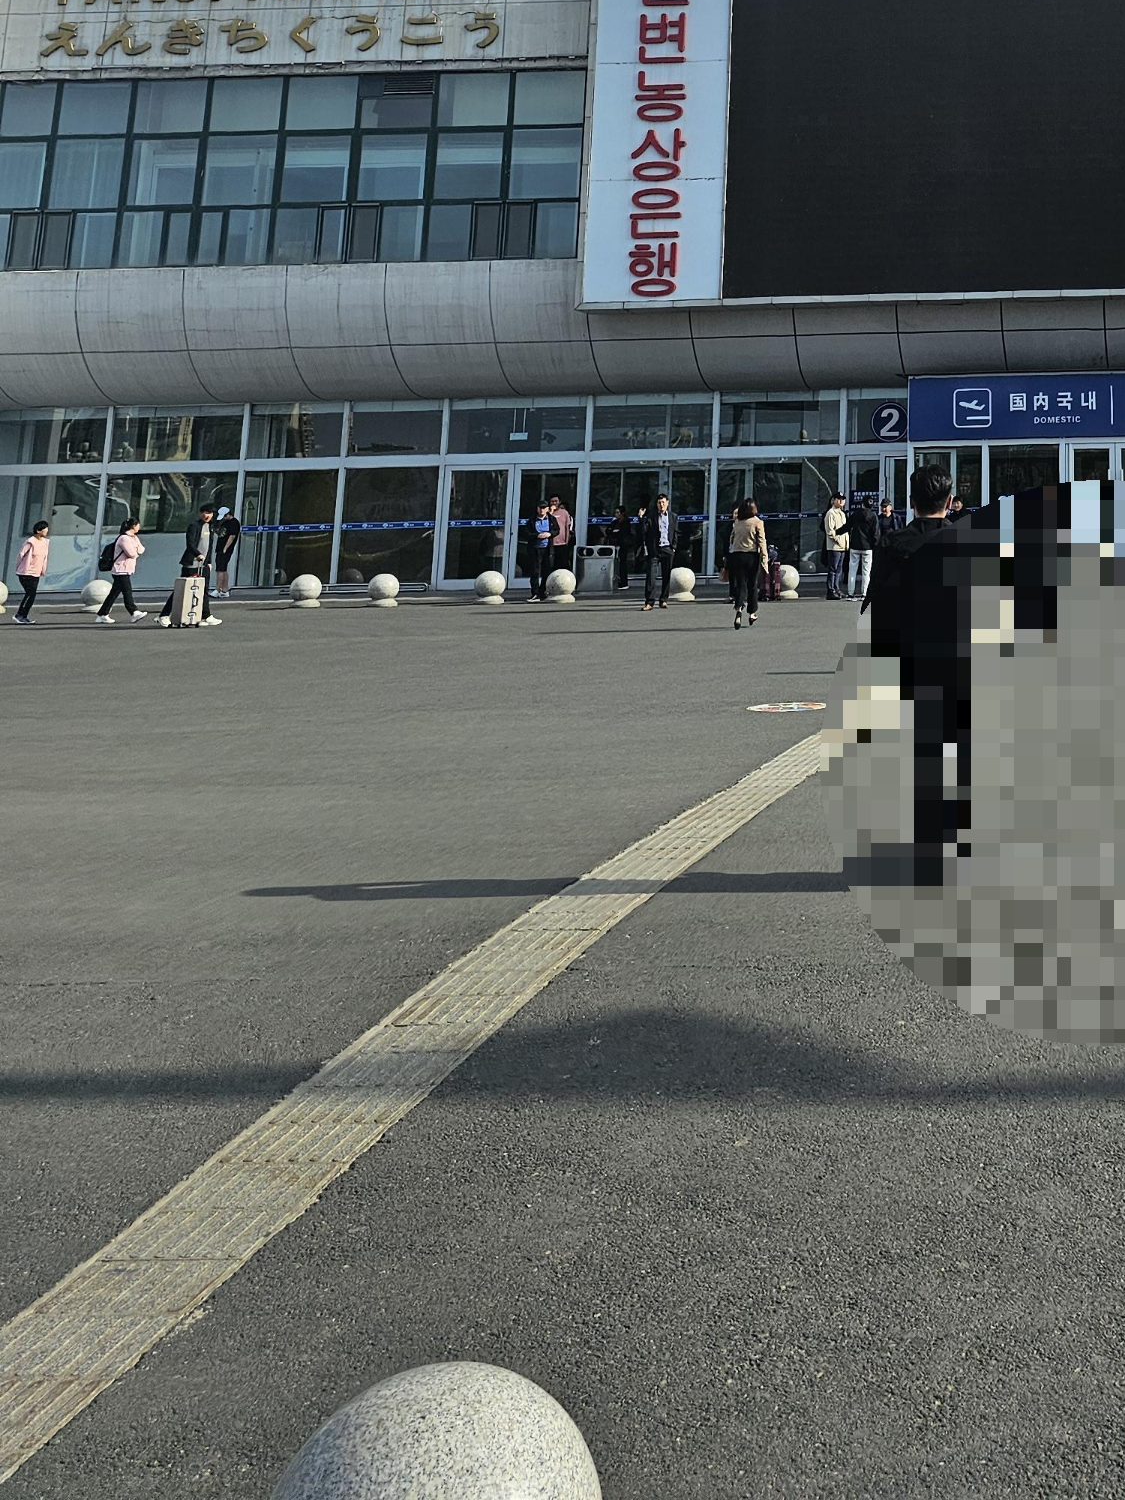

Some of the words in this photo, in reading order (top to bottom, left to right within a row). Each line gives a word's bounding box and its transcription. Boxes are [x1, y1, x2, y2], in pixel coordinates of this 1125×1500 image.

[39, 12, 501, 57] えんきちくうこう
[1009, 392, 1049, 412] 国内
[1055, 390, 1098, 411] 국내
[880, 408, 900, 438] 2
[1033, 415, 1081, 425] DOMESTIC
